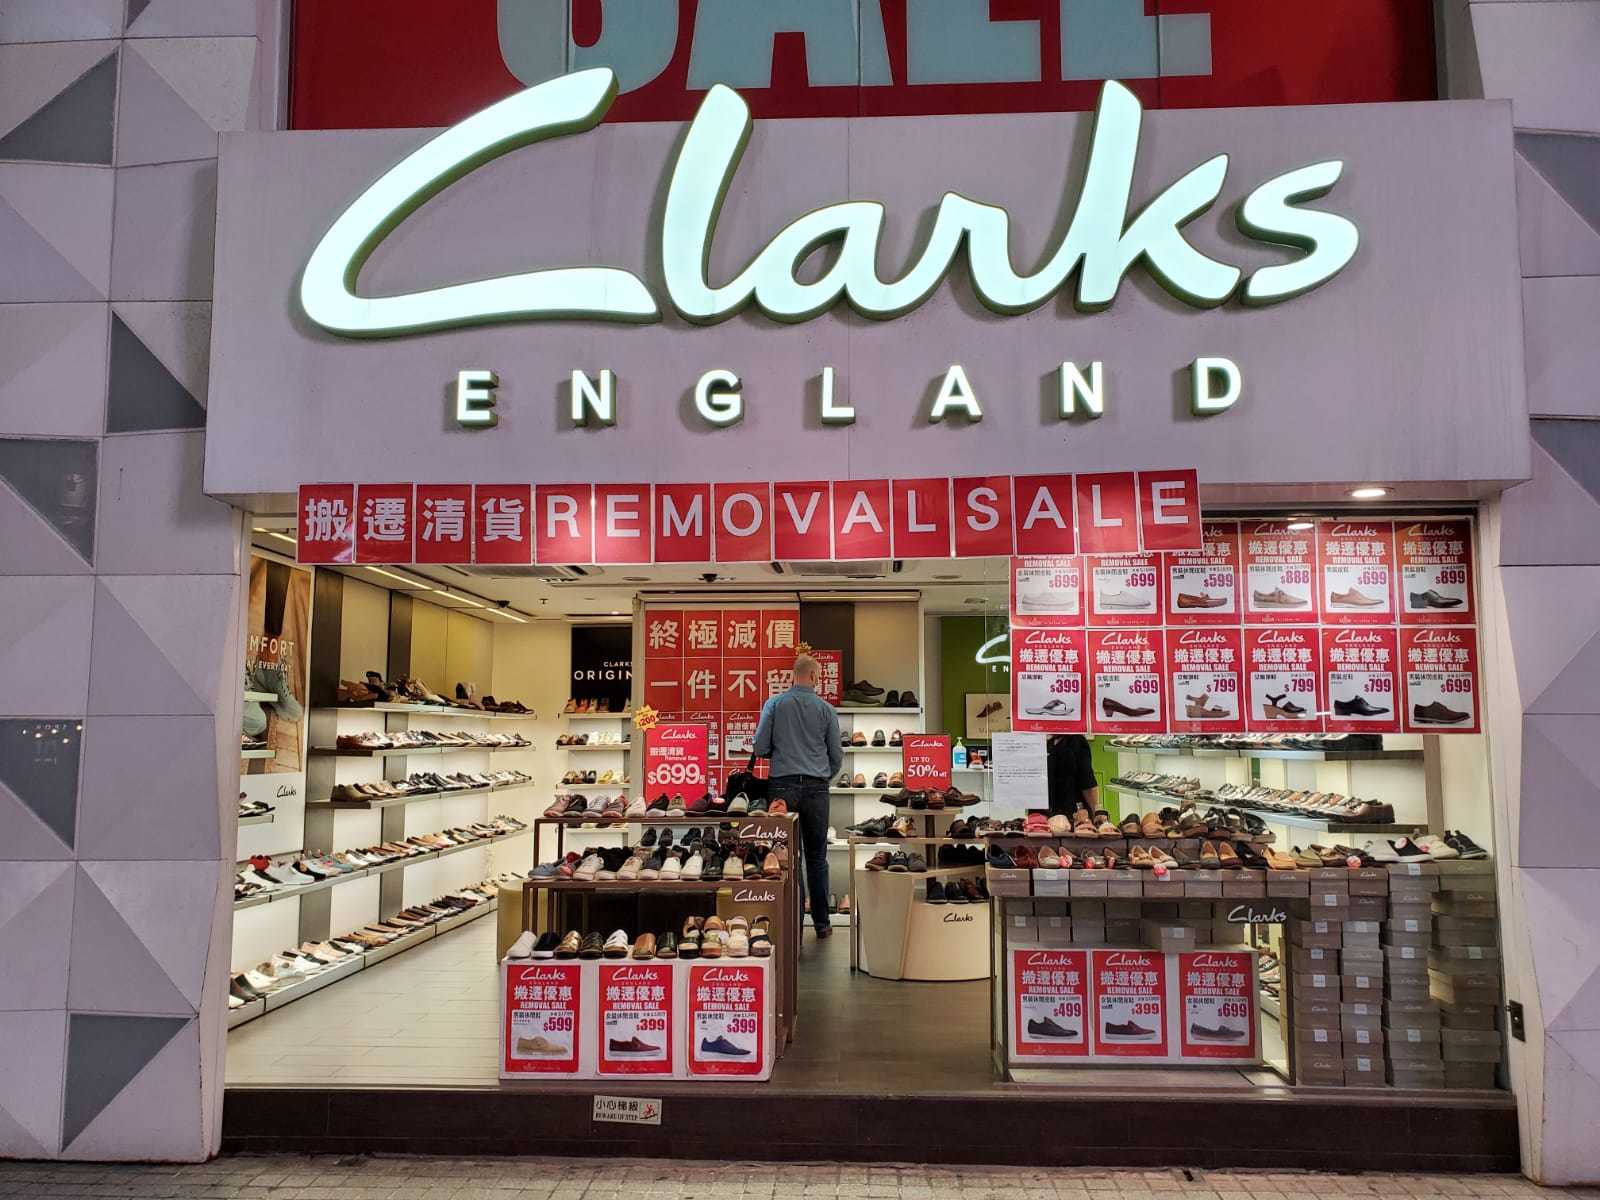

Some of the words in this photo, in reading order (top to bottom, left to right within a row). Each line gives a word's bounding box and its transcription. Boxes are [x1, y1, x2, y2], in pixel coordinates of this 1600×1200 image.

[301, 67, 1359, 333] Clarks
[456, 357, 1242, 424] ENGLAND
[304, 497, 526, 543] 搬遷清貨
[546, 490, 937, 539] REMOVAL
[966, 480, 1189, 532] SALE
[1331, 524, 1377, 537] Clarks
[1049, 574, 1079, 588] $699
[1126, 573, 1155, 587] $699
[1204, 573, 1233, 587] $599
[1280, 570, 1310, 584] $888
[1358, 571, 1387, 585] $699
[1435, 570, 1465, 584] $899
[650, 620, 795, 649] 終極減價
[1025, 631, 1072, 644] Clarks
[1101, 632, 1148, 646] Clarks
[1180, 630, 1226, 644] Clarks
[1258, 630, 1305, 644] Clarks
[1335, 630, 1382, 643] Clarks
[1414, 630, 1461, 643] Clarks
[249, 635, 295, 656] MFORT
[574, 670, 632, 680] ORIGIN
[650, 669, 794, 699] 一件不留
[1050, 679, 1080, 693] $399
[1128, 680, 1158, 694] $699
[1206, 678, 1236, 693] $799
[1285, 678, 1314, 693] $799
[1364, 679, 1391, 693] $799
[1441, 679, 1471, 693] $699
[661, 729, 697, 740] Clarks
[910, 740, 944, 748] Clarks
[907, 765, 938, 777] 50%
[740, 824, 788, 839] Clarks
[734, 889, 776, 902] Clarks
[943, 912, 973, 922] Clarks
[1227, 905, 1287, 922] Clarks
[1028, 952, 1073, 966] Clarks
[1106, 953, 1151, 966] Clarks
[1193, 954, 1238, 967] Clarks
[521, 967, 566, 981] Clarks
[612, 967, 658, 981] Clarks
[702, 968, 749, 982] Clarks
[1053, 1003, 1081, 1017] $499
[1132, 1003, 1159, 1015] $399
[1218, 1003, 1247, 1017] $699
[543, 1017, 572, 1032] $599
[636, 1019, 665, 1031] $399
[727, 1018, 756, 1033] $399
